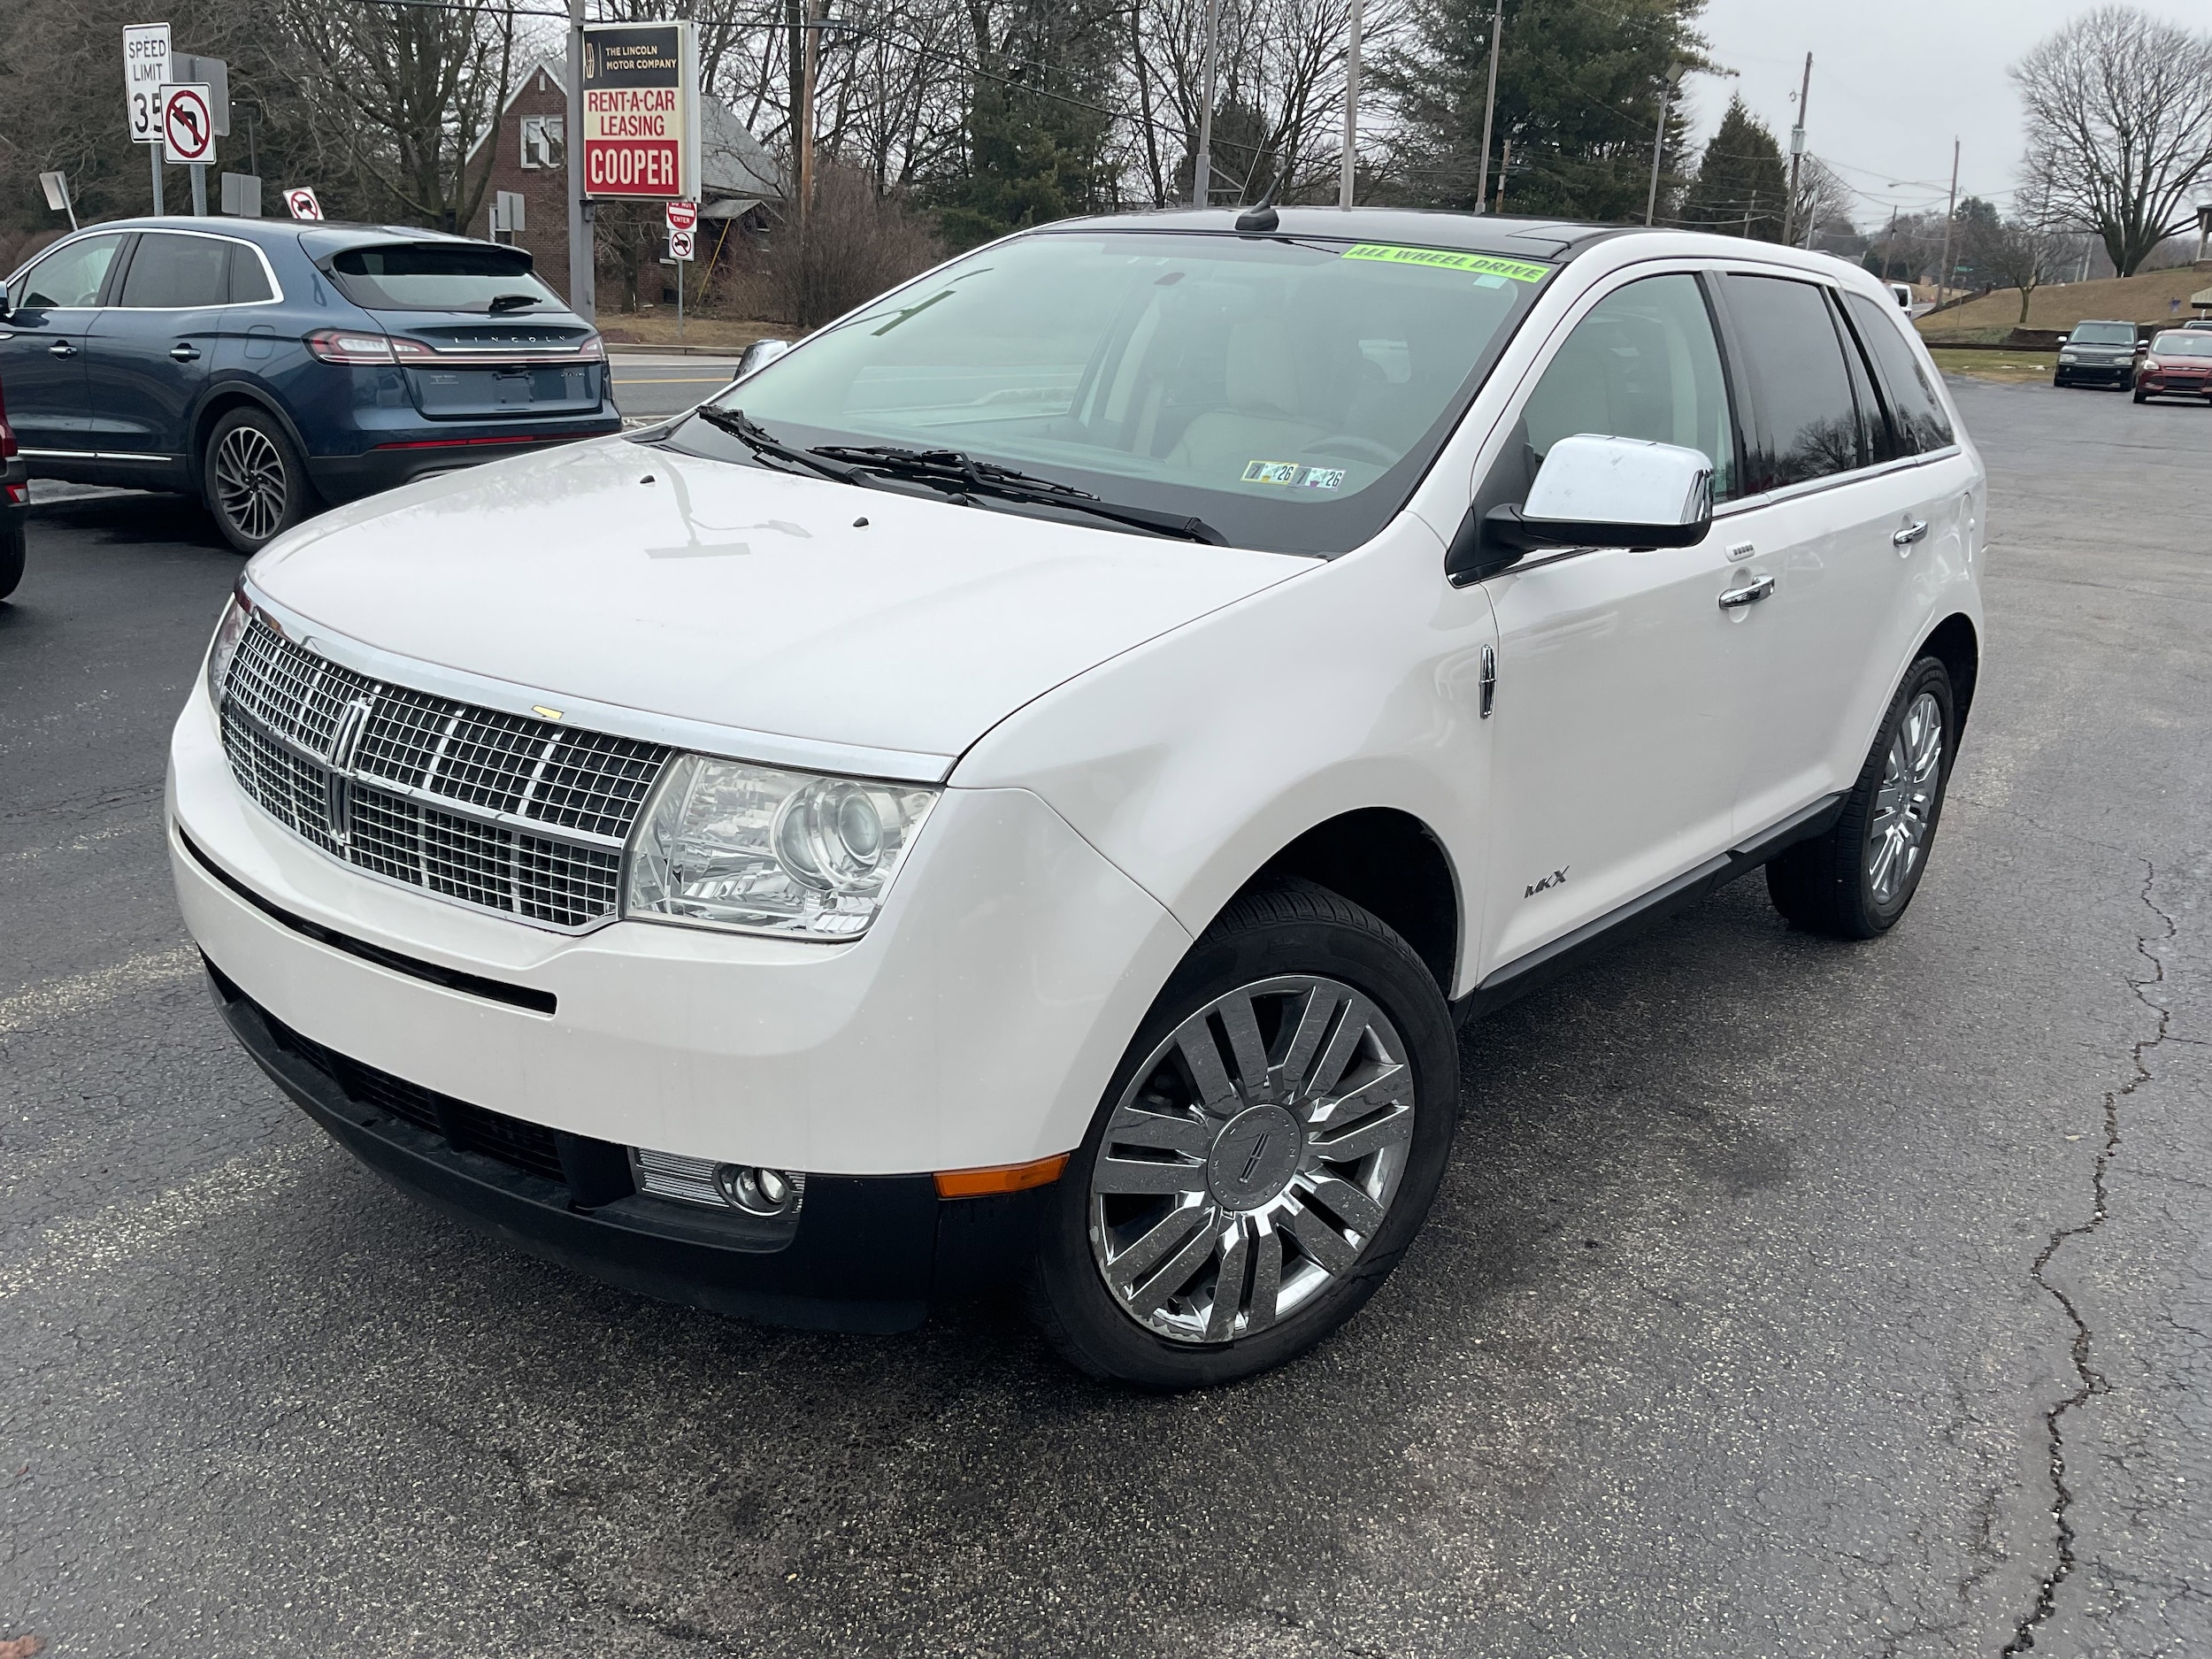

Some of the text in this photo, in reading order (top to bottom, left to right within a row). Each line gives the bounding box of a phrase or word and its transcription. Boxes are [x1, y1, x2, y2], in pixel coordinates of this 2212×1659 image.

[128, 39, 166, 58] SPEED
[605, 45, 657, 56] THE LINCOLN
[133, 64, 163, 81] LIMIT
[606, 59, 677, 70] MOTOR COMPANY
[588, 90, 675, 111] RENT-A-CAR
[601, 115, 664, 136] LEASING
[590, 149, 674, 186] COOPER
[672, 215, 690, 224] ENTER
[1349, 247, 1544, 280] ALL WHEEL DRIVE
[1277, 465, 1294, 481] 26
[1325, 471, 1342, 488] 26
[1524, 864, 1570, 899] MKX
